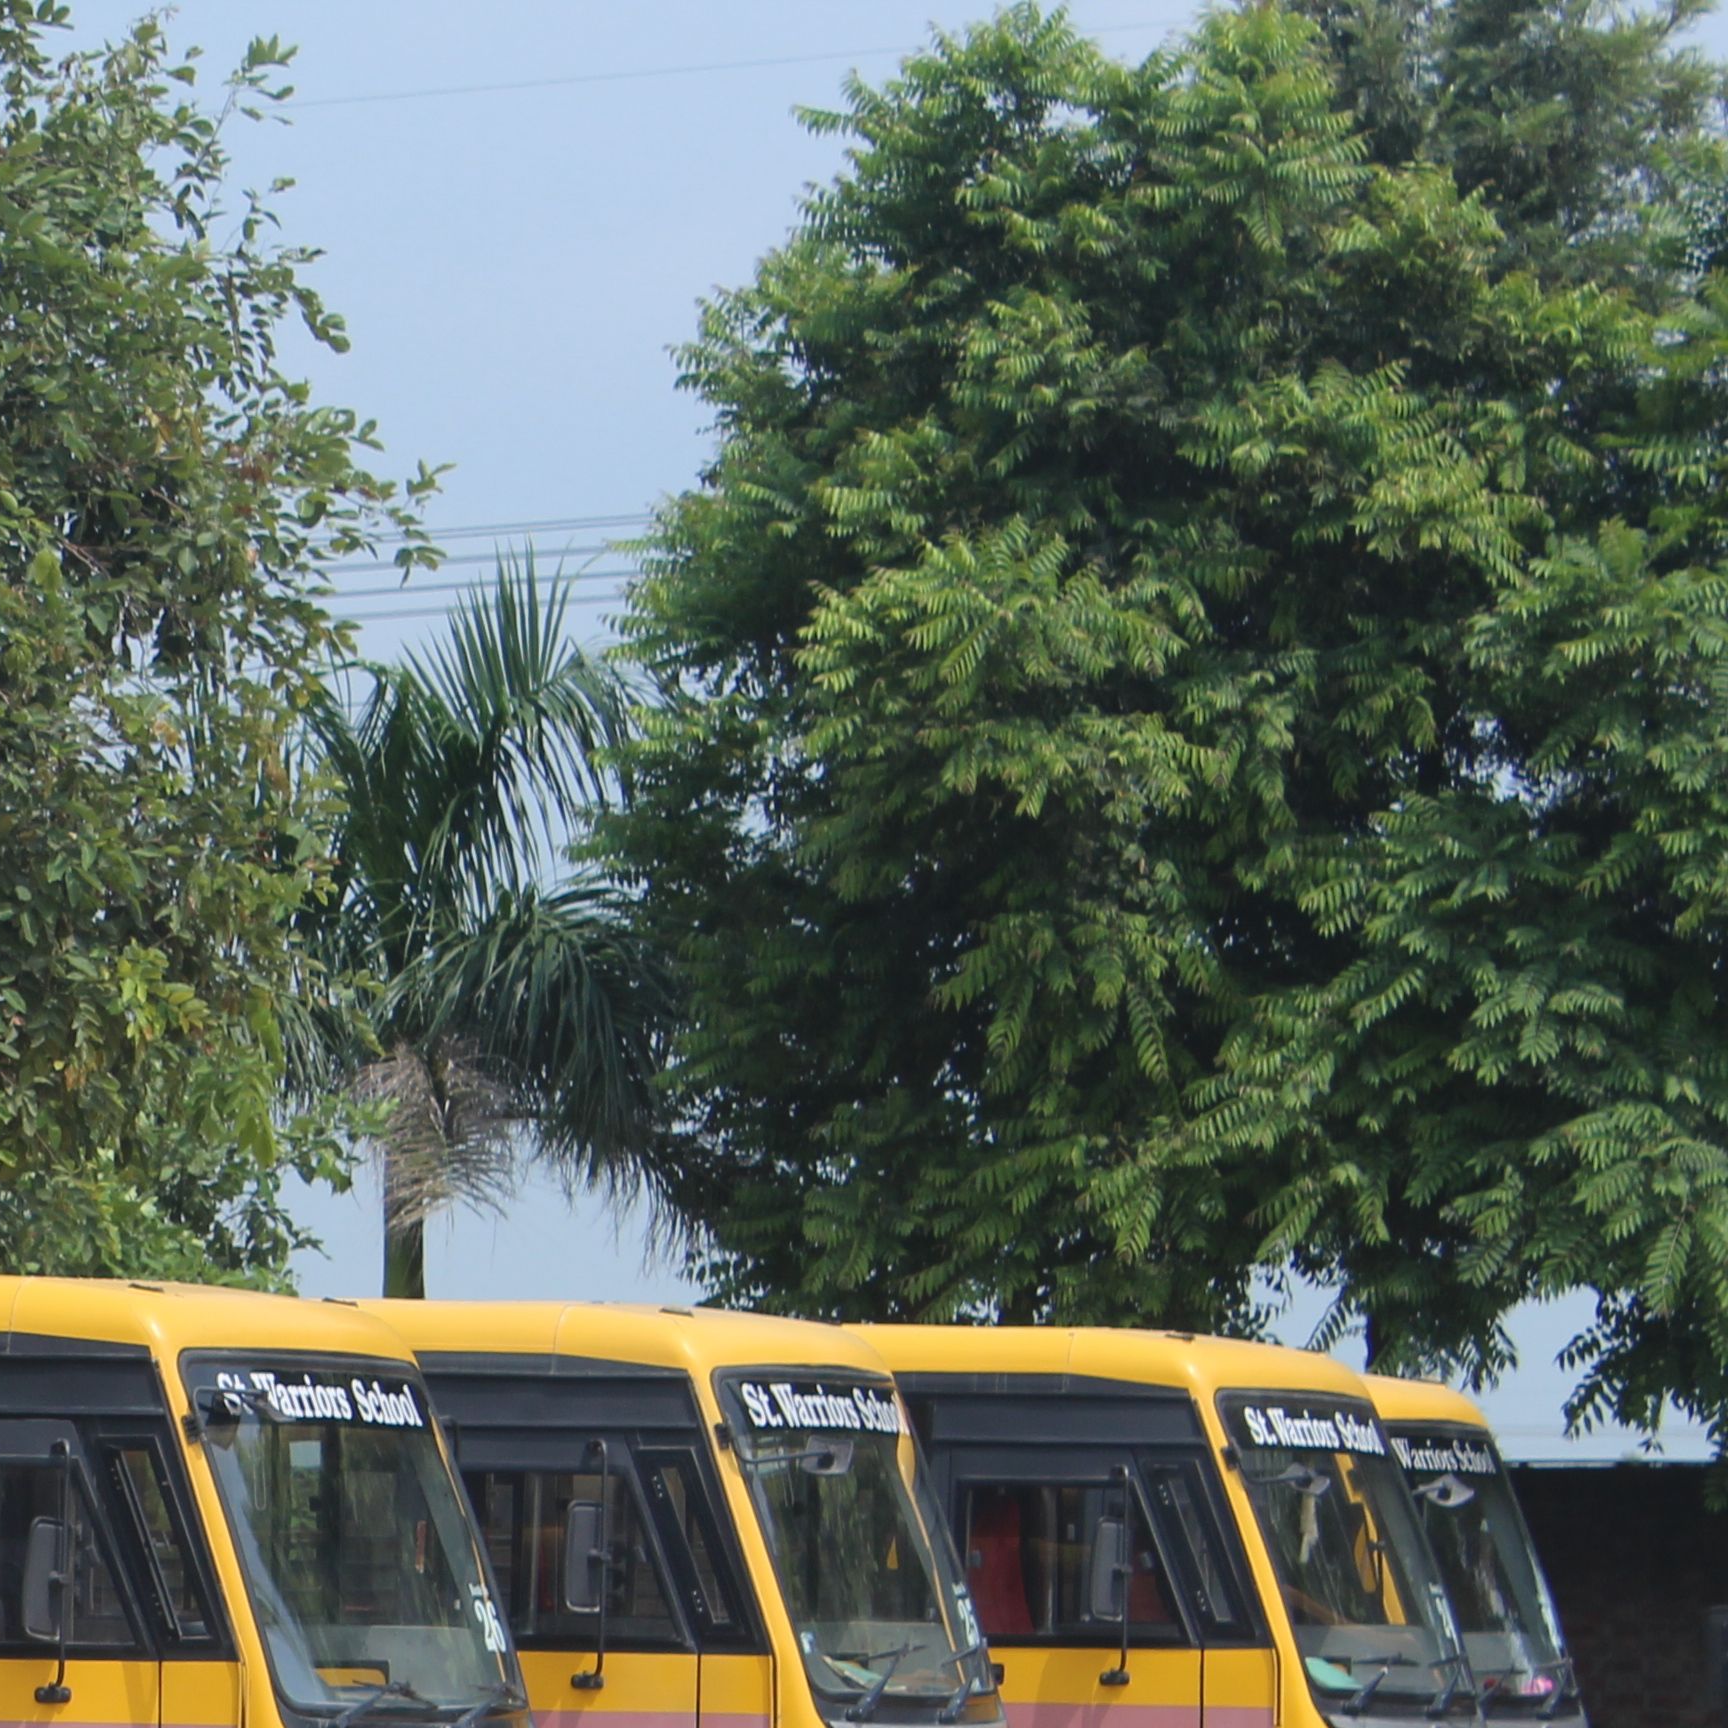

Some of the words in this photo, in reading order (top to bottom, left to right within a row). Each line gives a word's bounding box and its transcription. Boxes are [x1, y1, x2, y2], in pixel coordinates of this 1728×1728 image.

[351, 1378, 423, 1427] School
[852, 1386, 911, 1436] School
[1335, 1411, 1385, 1457] School
[1391, 1437, 1459, 1472] Warriors
[1452, 1440, 1497, 1475] School
[474, 1599, 507, 1653] 26
